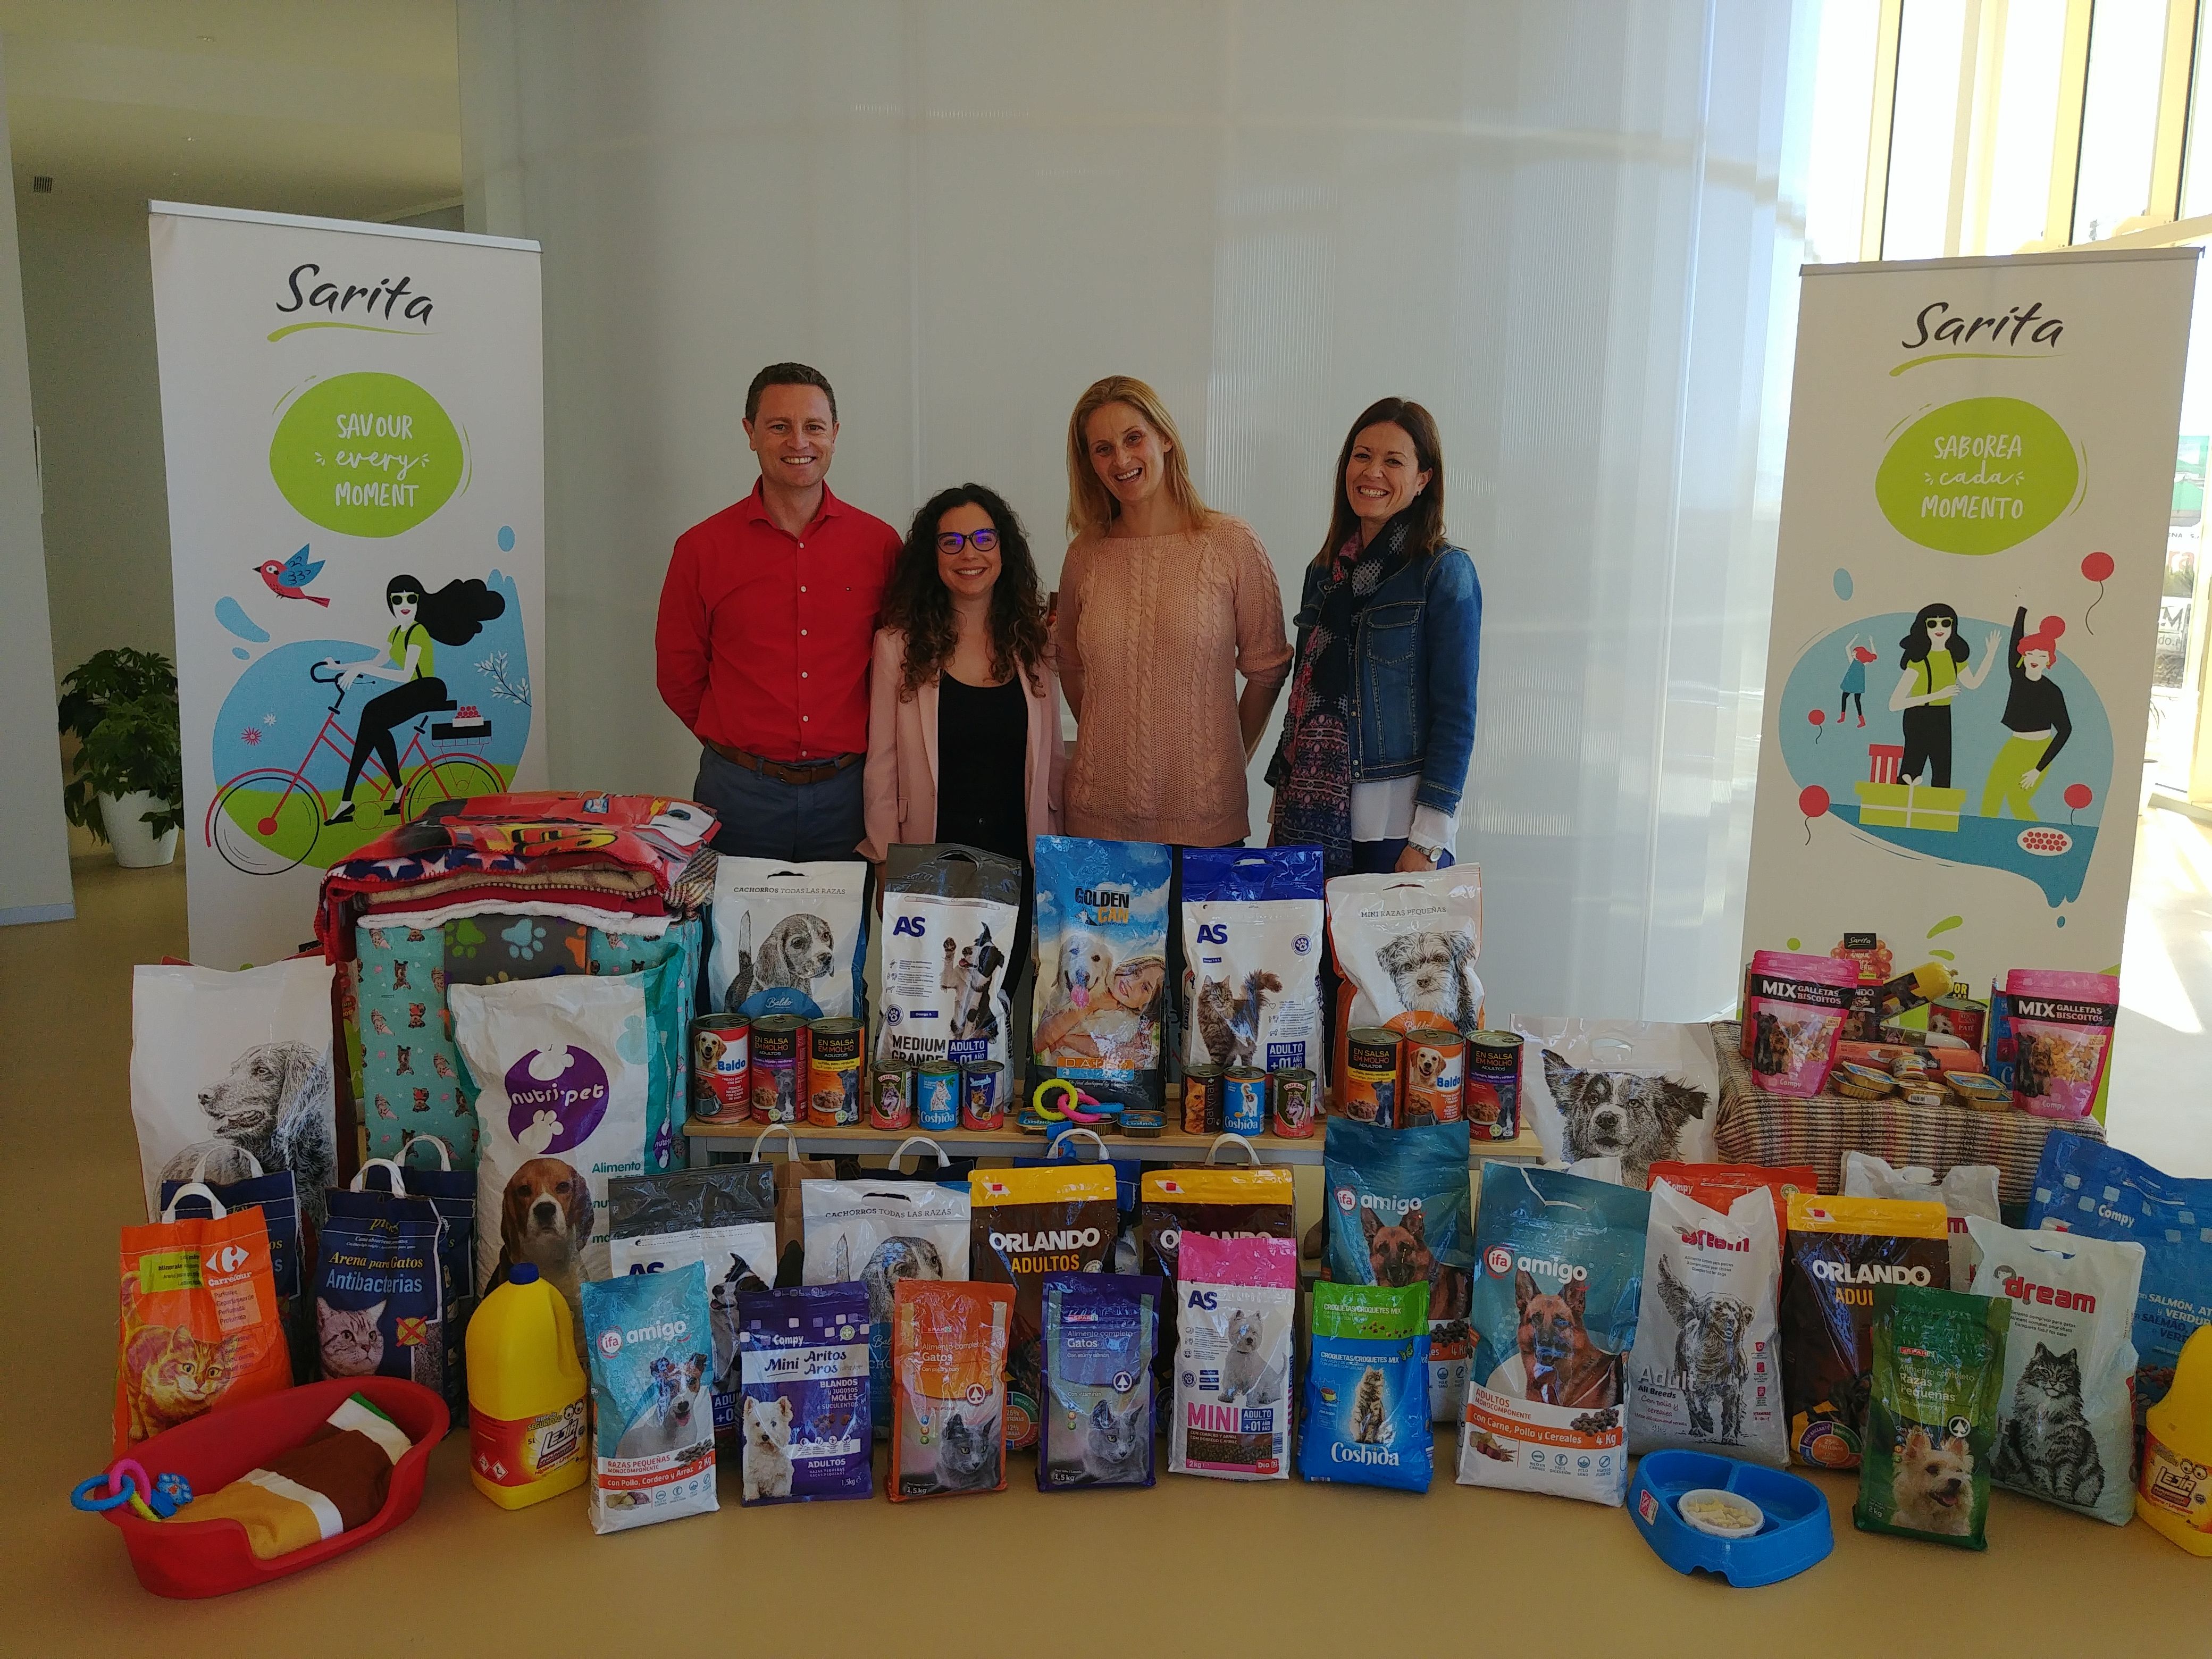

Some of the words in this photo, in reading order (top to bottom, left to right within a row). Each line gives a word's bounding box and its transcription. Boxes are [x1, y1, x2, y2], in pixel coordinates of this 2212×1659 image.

[276, 264, 433, 325] Sarita
[1901, 301, 2064, 349] Sarita
[336, 413, 413, 440] SAVOUR
[1933, 434, 2022, 460] SABOREA
[335, 450, 420, 481] every
[1939, 460, 2015, 486] cada
[335, 482, 419, 508] MOMENT
[1920, 496, 2024, 520] MOMENTO
[1075, 887, 1129, 909] GOLDEN
[1098, 907, 1129, 924] CAN
[1406, 906, 1447, 917] PEQUEÑAS
[892, 916, 926, 937] AS
[1196, 924, 1228, 945] AS
[1848, 936, 1871, 944] Sarita
[1762, 979, 1797, 999] MIX
[1797, 985, 1839, 997] GALLETAS
[765, 997, 793, 1009] Baldo
[1797, 993, 1841, 1004] BISCOITOS
[2018, 1000, 2056, 1018] MIX
[2056, 1004, 2102, 1014] GALLETAS
[2056, 1011, 2104, 1022] BISCOITOS
[764, 1036, 789, 1044] SALSA
[892, 1034, 946, 1053] MEDIUM
[950, 1040, 985, 1052] ADULTO
[1269, 1043, 1303, 1054] ADULTO
[717, 1058, 745, 1071] Baldo
[1437, 1075, 1460, 1088] Baldo
[1780, 1078, 1802, 1089] Compy
[2041, 1100, 2066, 1111] Compy
[920, 1111, 955, 1125] Coshida
[1224, 1116, 1258, 1130] Coshida
[592, 1160, 641, 1174] Alimento
[825, 1208, 877, 1218] CACHORROS
[877, 1209, 905, 1218] TODAS
[1338, 1193, 1352, 1205] ifa
[1360, 1194, 1422, 1216] amigo
[2098, 1204, 2135, 1228] Compy
[989, 1227, 1100, 1253] ORLANDO
[328, 1251, 367, 1267] Arena
[368, 1260, 390, 1270] para
[390, 1256, 424, 1268] Gatos
[1011, 1254, 1080, 1273] ADULTOS
[1492, 1253, 1507, 1267] ifa
[1517, 1256, 1587, 1285] amigo
[208, 1271, 252, 1287] Carrefour
[325, 1269, 423, 1294] Antibacterias
[1812, 1259, 1931, 1287] ORLANDO
[1188, 1291, 1217, 1312] AS
[2005, 1276, 2096, 1314] dream
[2148, 1293, 2195, 1314] SALMÓN,
[605, 1337, 618, 1348] ifa
[626, 1319, 687, 1344] amigo
[773, 1334, 804, 1347] Compy
[1067, 1338, 1098, 1348] Gatos
[764, 1357, 799, 1372] Mini
[803, 1350, 847, 1362] Aritos
[922, 1352, 953, 1362] Gatos
[803, 1363, 838, 1375] Aros
[1899, 1363, 1935, 1376] Alimento
[1936, 1370, 1974, 1382] completo
[820, 1379, 858, 1388] BLANDOS
[1637, 1365, 1697, 1392] Adult
[1899, 1372, 1933, 1387] Razas
[831, 1393, 858, 1402] MOLES
[1476, 1388, 1510, 1407] ADULTOS
[1640, 1395, 1655, 1404] Con
[1649, 1387, 1677, 1399] Breeds
[1900, 1382, 1956, 1402] Pequeñas
[822, 1401, 859, 1410] SUCULENTOS
[1474, 1396, 1531, 1420] MONOCOMPONENTE
[1647, 1407, 1672, 1417] cereales
[527, 1414, 563, 1431] SEGURIDAD
[1187, 1402, 1238, 1432] MINI
[1243, 1410, 1272, 1419] ADULTO
[1244, 1421, 1261, 1431] +01
[1473, 1412, 1486, 1422] con
[1487, 1415, 1512, 1434] Carne,
[1514, 1425, 1536, 1438] Pollo
[1537, 1432, 1543, 1440] y
[1544, 1431, 1582, 1444] Cereales
[1596, 1435, 1603, 1445] 4
[1605, 1434, 1616, 1446] Kg
[540, 1418, 579, 1457] LEJÍA
[608, 1460, 631, 1469] RAZAS
[632, 1454, 671, 1467] PEQUEÑAS
[1331, 1442, 1400, 1467] Coshida
[608, 1464, 659, 1474] MONOCOMPONENTE
[621, 1478, 641, 1487] Pollo,
[642, 1473, 669, 1485] Cordero
[676, 1466, 694, 1478] Arroz
[698, 1460, 703, 1470] 2
[703, 1455, 711, 1467] Kg
[808, 1459, 846, 1468] ADULTOS
[841, 1478, 856, 1487] 1,5kg
[1066, 1473, 1075, 1482] kg
[918, 1486, 927, 1495] kg
[1873, 1507, 1883, 1518] kg
